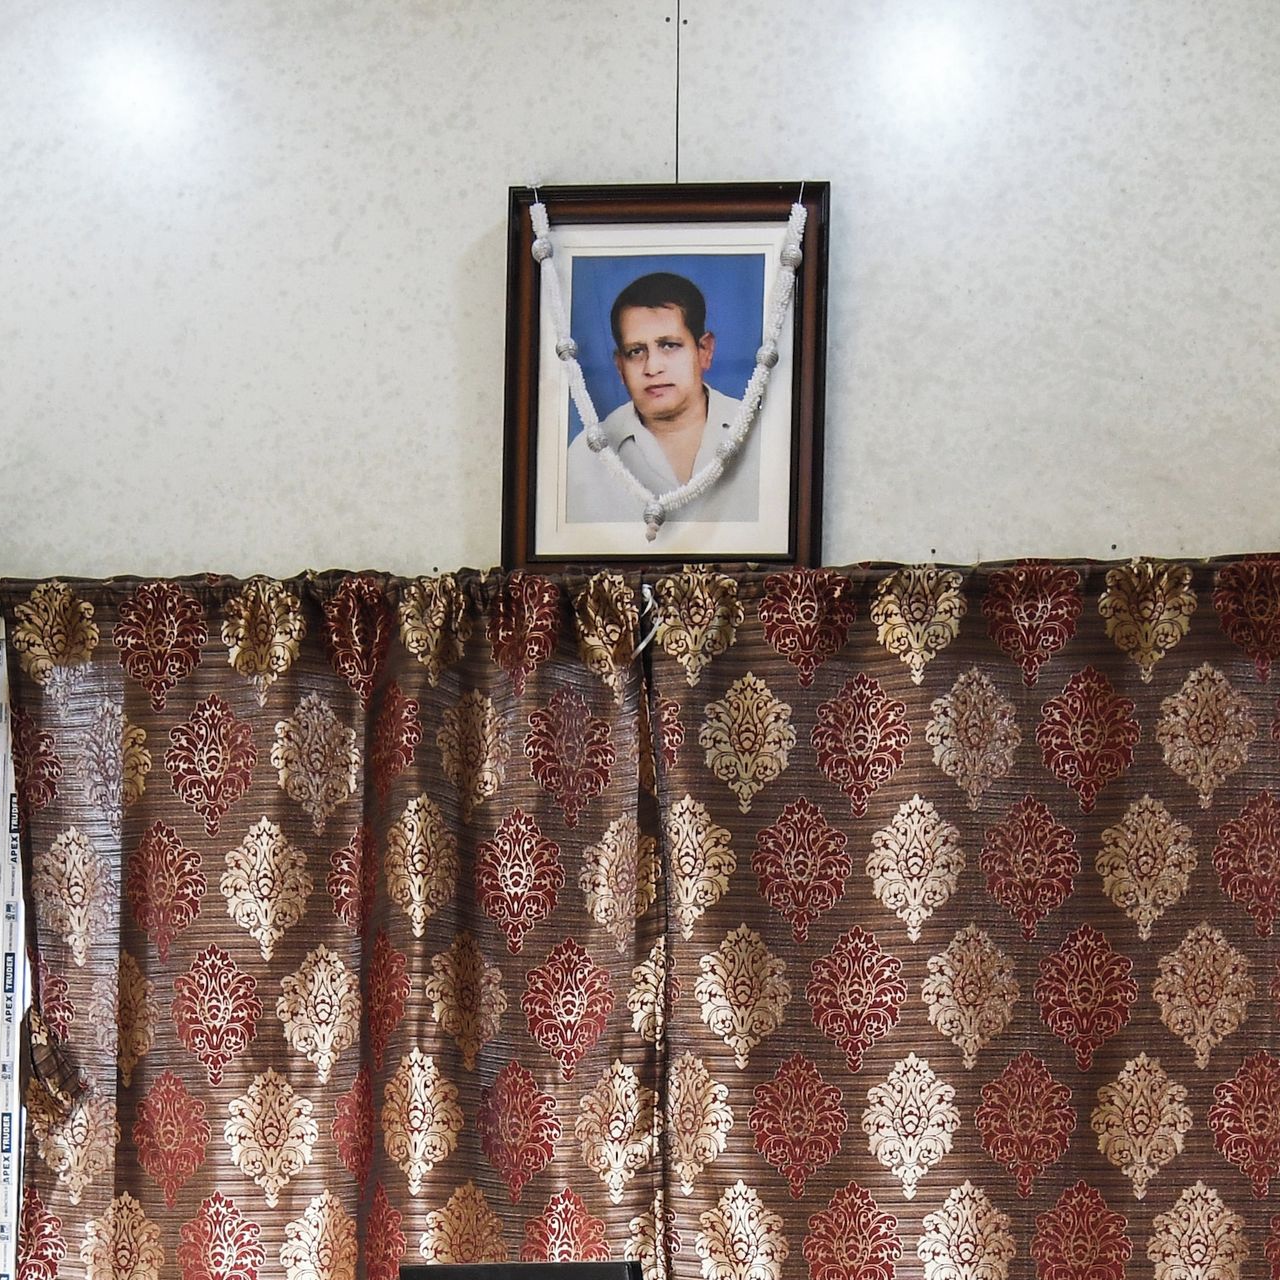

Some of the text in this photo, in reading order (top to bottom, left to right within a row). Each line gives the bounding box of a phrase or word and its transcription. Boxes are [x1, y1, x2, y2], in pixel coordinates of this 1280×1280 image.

[10, 835, 19, 864] APEX
[5, 955, 15, 992] TRUDER
[4, 995, 13, 1024] APEX
[1, 1115, 11, 1152] TRUDER
[2, 1153, 11, 1185] APEX
